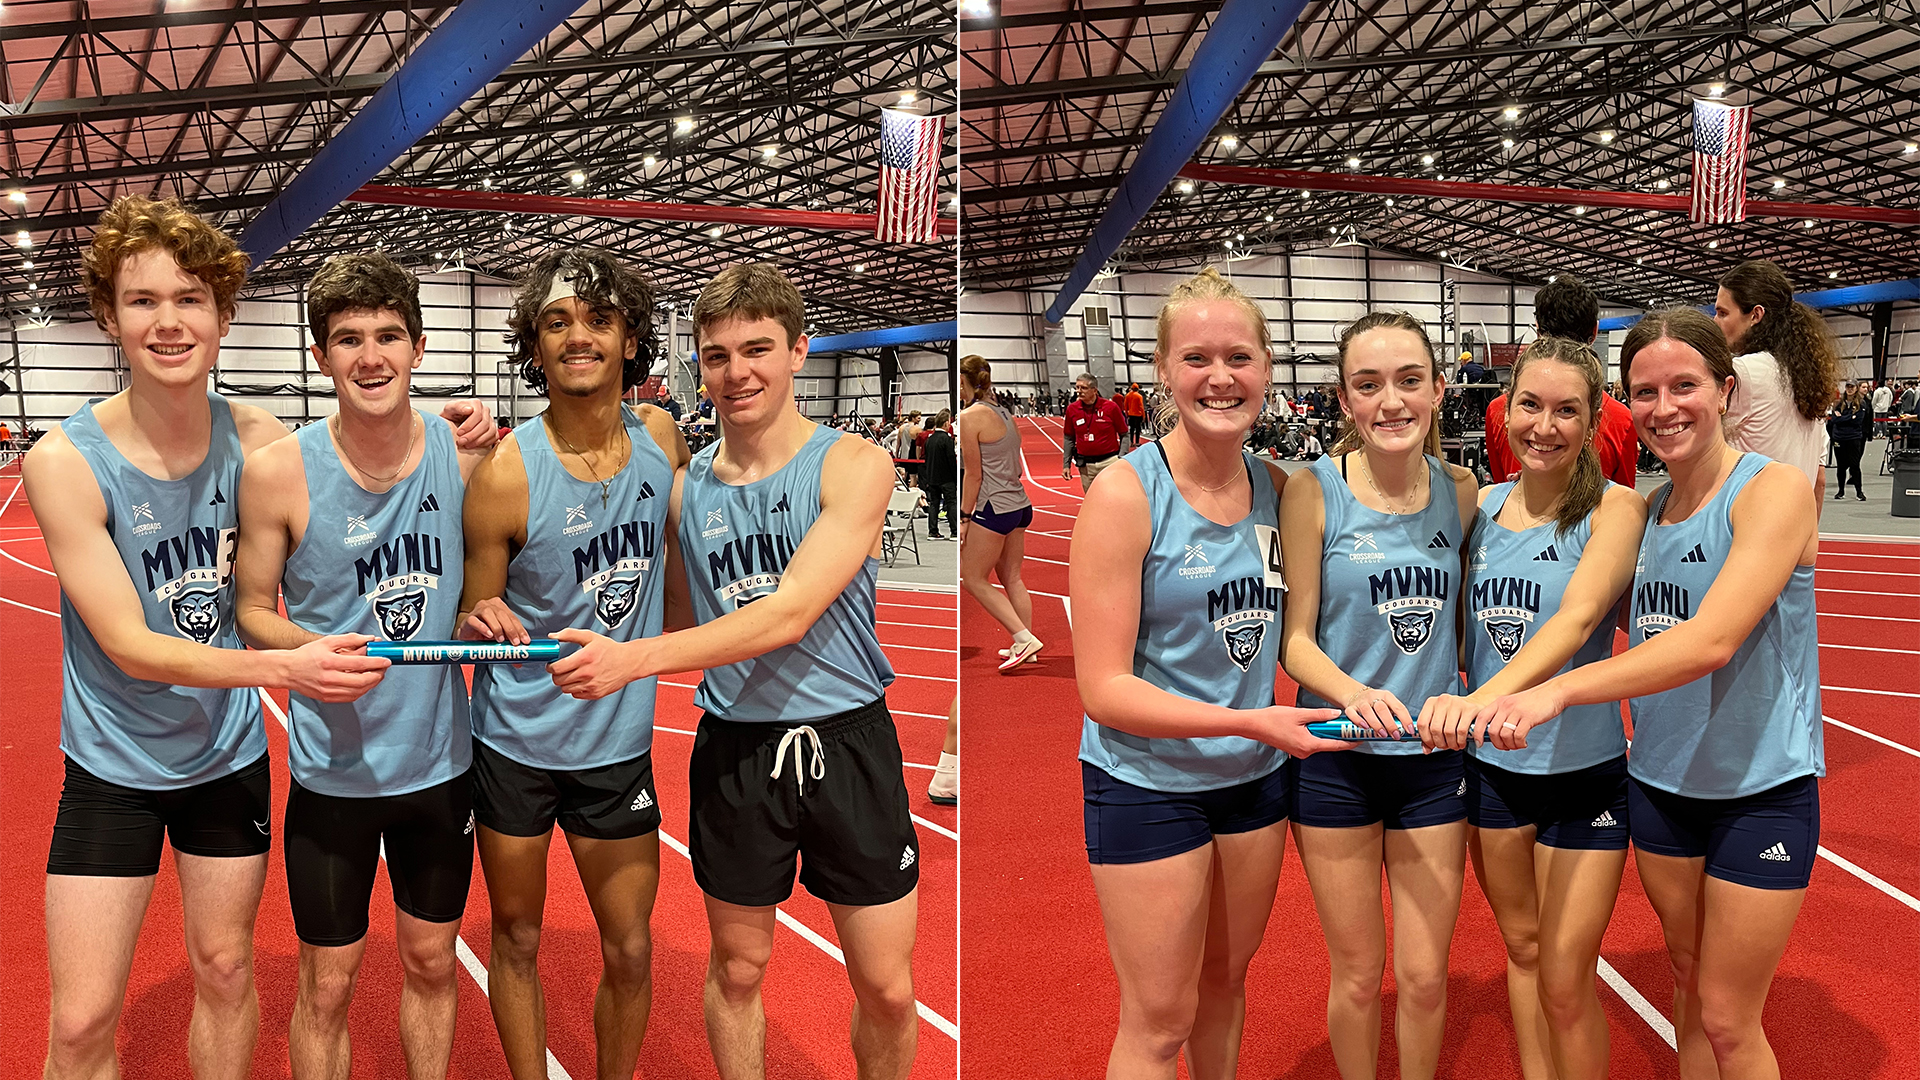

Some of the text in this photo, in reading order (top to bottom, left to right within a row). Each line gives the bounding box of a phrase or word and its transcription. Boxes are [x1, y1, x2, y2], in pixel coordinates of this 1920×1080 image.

[350, 539, 373, 547] LEAGUE
[572, 521, 655, 585] MVNU
[141, 526, 220, 593] MVN
[221, 531, 236, 585] 3
[354, 532, 443, 597] MVNU
[1268, 530, 1285, 586] 4
[1348, 552, 1386, 561] CROSSROADS
[1178, 565, 1217, 576] CROSSROADS
[164, 572, 218, 595] COGAR
[371, 575, 429, 597] OUGRS
[728, 576, 780, 594] COUGA
[1368, 565, 1449, 607] MVNU
[1206, 576, 1278, 623] MVNU
[1384, 599, 1438, 610] COUGARS
[1472, 576, 1541, 614] MVNU
[1635, 581, 1689, 621] MVNU
[1220, 611, 1269, 627] COUGARS
[1481, 608, 1528, 619] COUGARS
[1640, 615, 1679, 626] COUGARS
[402, 646, 530, 661] MVNU COUGARS
[1591, 819, 1617, 827] adidas
[1759, 852, 1791, 862] adidas
